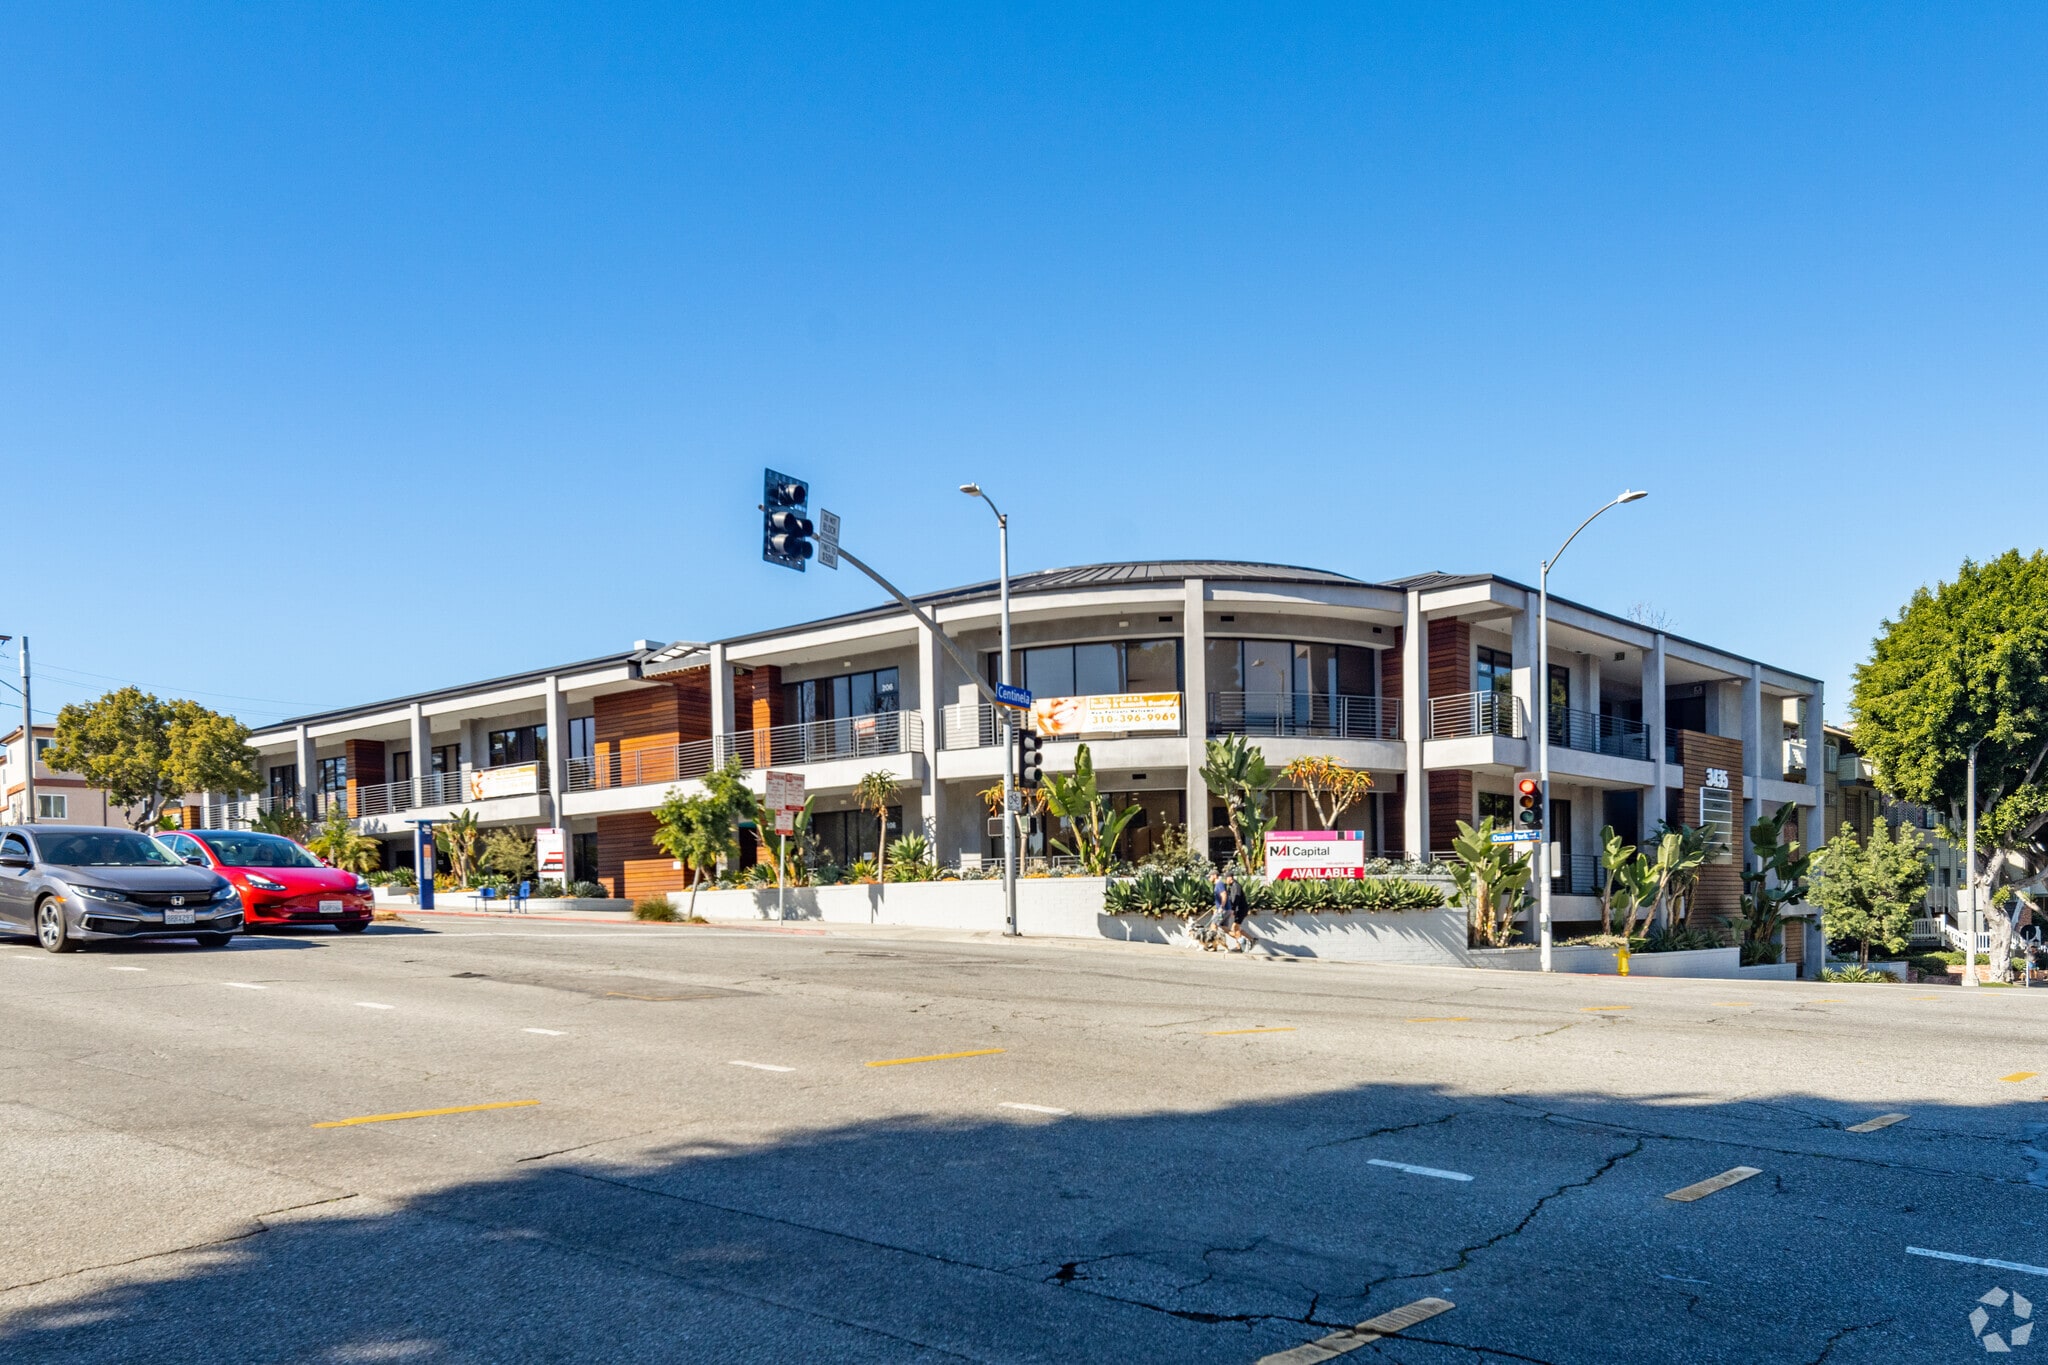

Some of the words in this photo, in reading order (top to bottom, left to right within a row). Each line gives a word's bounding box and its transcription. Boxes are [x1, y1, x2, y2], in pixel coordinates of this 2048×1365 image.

[823, 522, 836, 535] BLOCK
[998, 686, 1030, 704] Centinela
[1092, 713, 1176, 724] 310-396-9969
[1270, 844, 1290, 856] NAI
[1292, 846, 1330, 858] Capital
[1290, 868, 1355, 878] AVAILABLE
